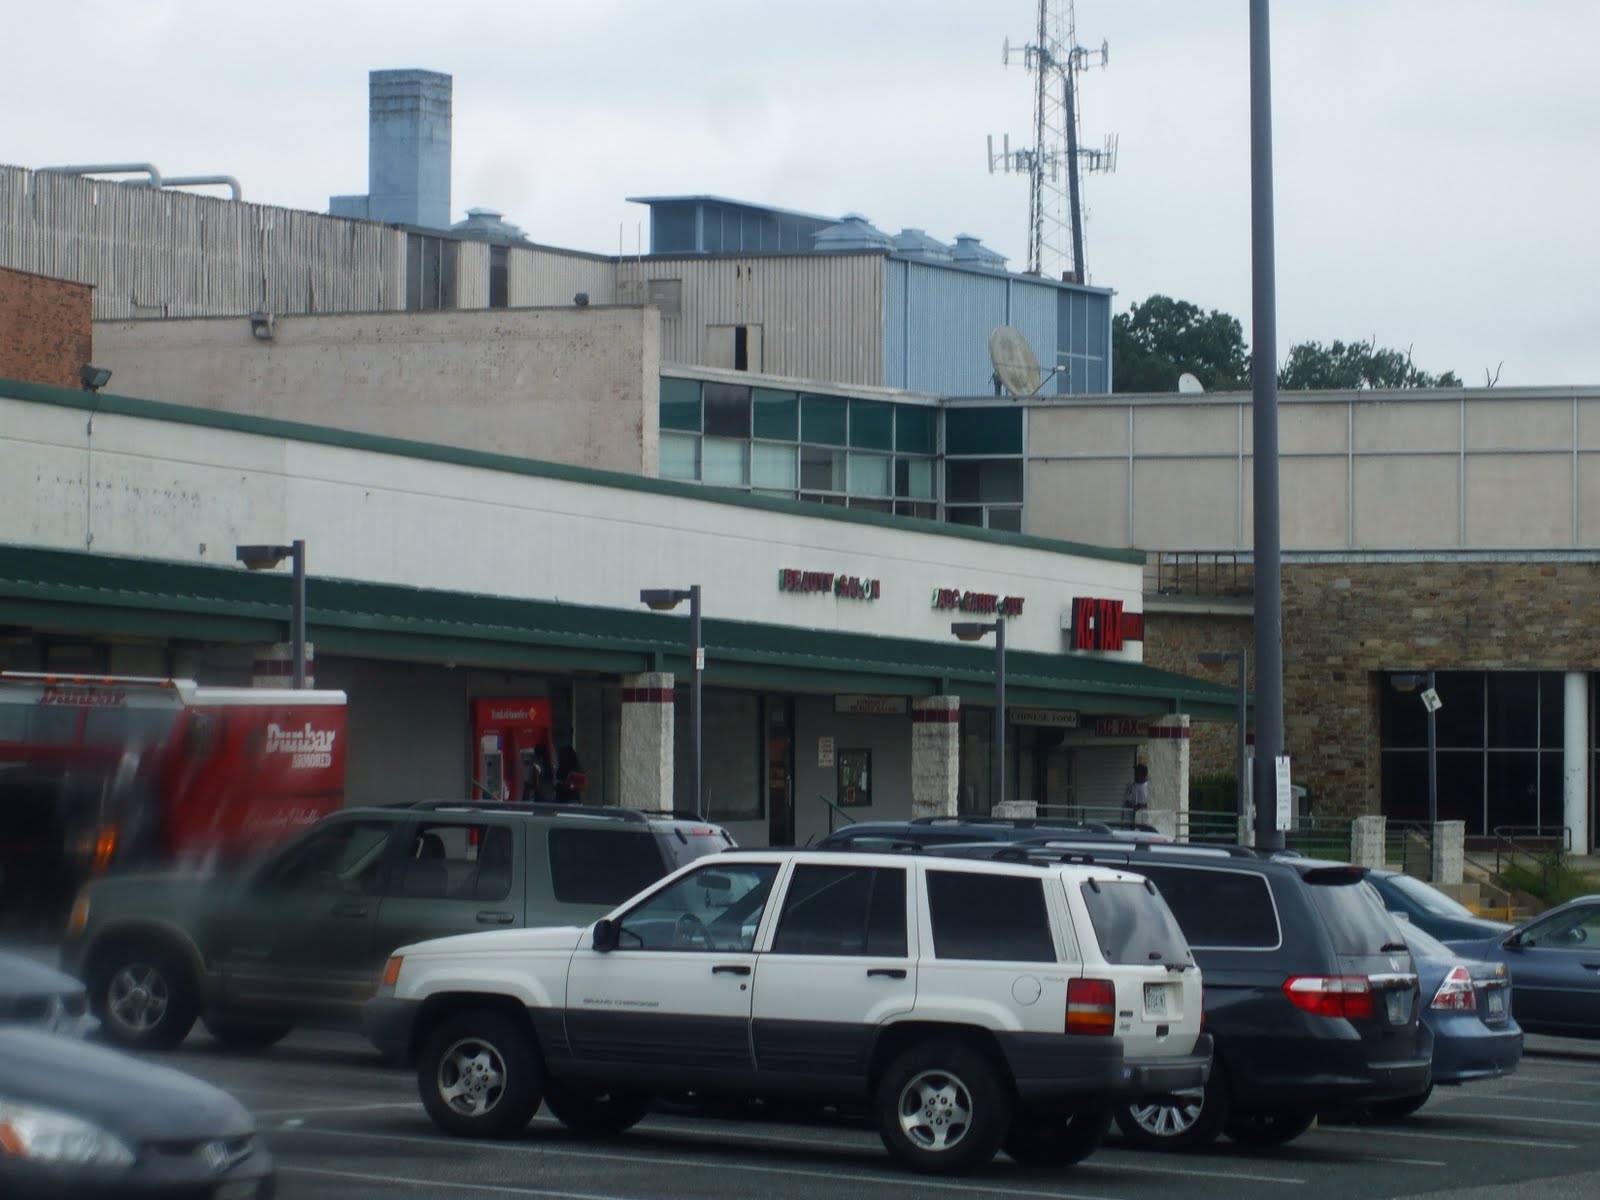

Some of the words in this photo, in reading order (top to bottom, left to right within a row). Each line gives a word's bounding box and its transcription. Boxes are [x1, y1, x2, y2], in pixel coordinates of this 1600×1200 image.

[780, 569, 834, 593] BEAUTY
[836, 574, 880, 600] SALON
[962, 591, 998, 614] CARRY
[1099, 599, 1122, 651] TAX
[1052, 712, 1076, 723] FOOD
[1118, 719, 1138, 737] TAX
[265, 721, 336, 753] Dunbar
